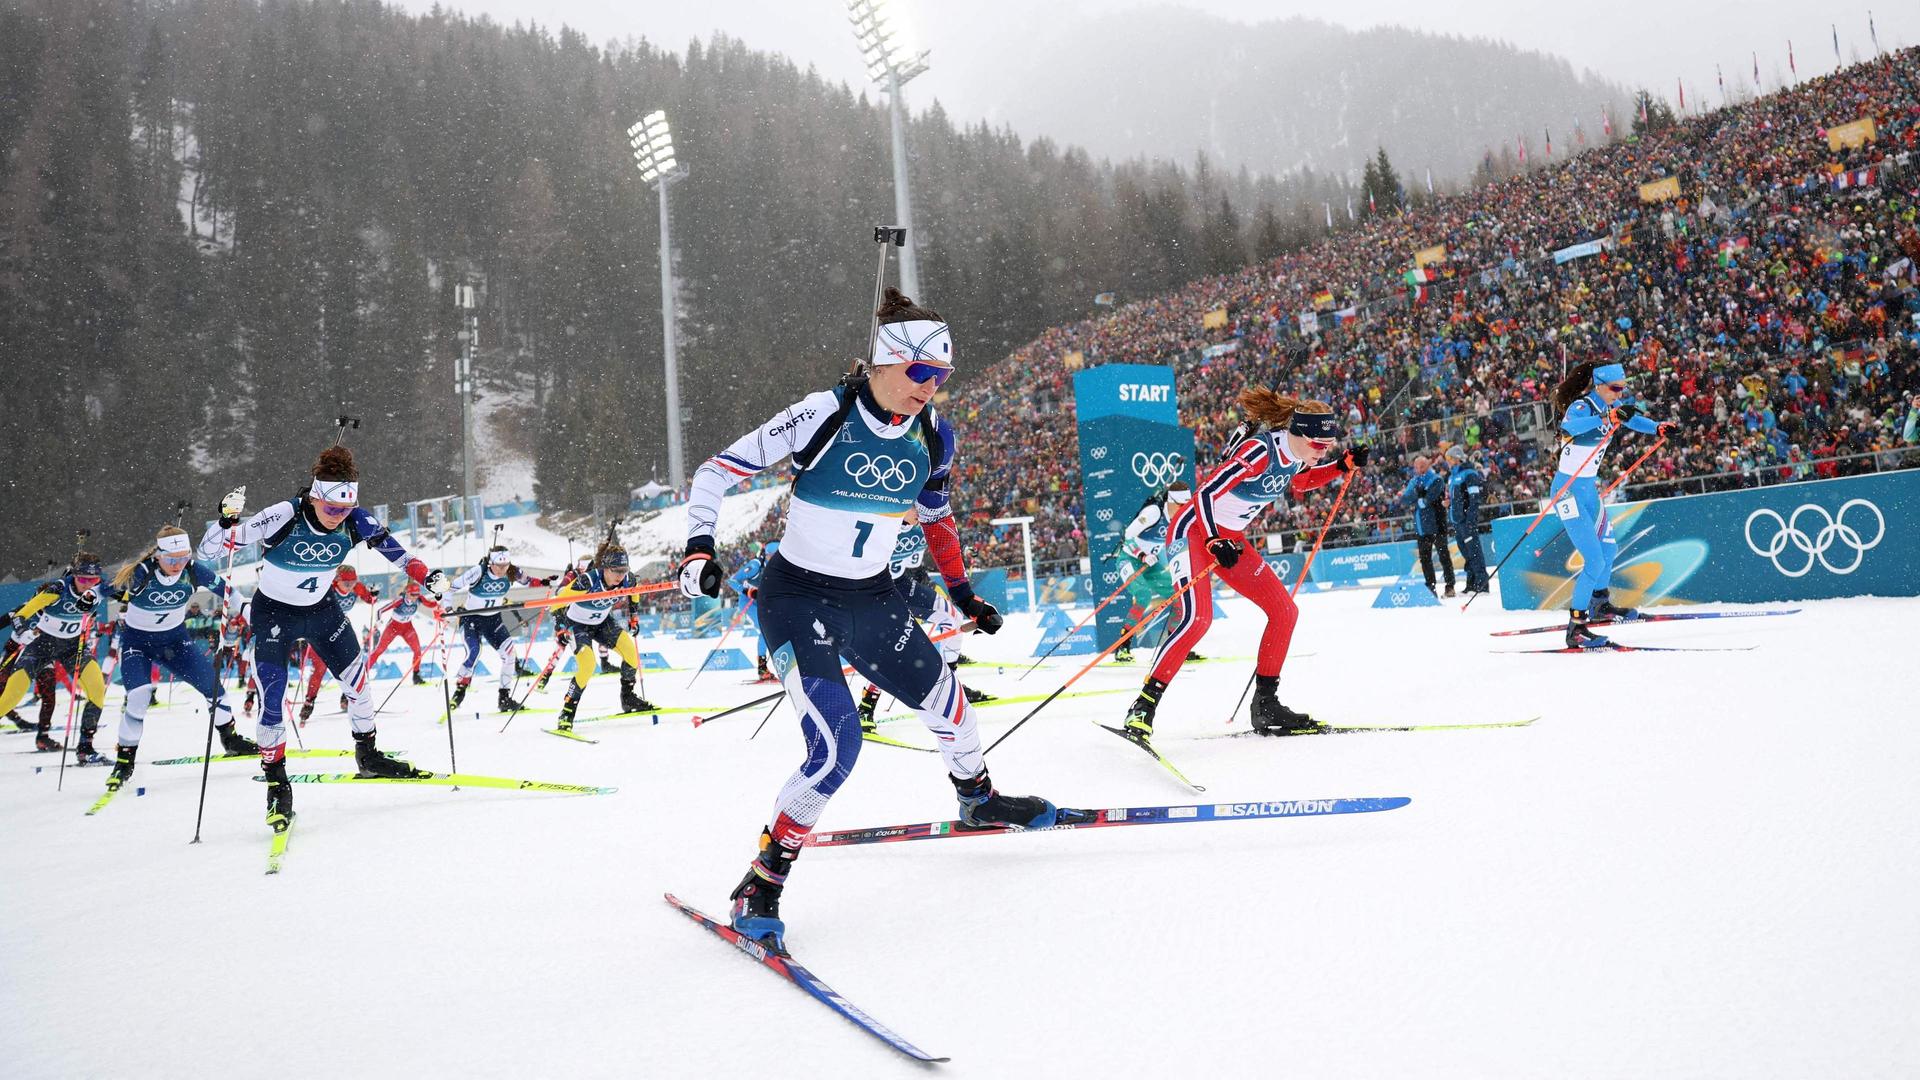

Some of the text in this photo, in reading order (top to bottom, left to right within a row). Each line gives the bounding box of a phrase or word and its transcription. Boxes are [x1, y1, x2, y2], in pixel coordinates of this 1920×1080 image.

[1118, 383, 1170, 402] START
[769, 412, 806, 437] CRAFT
[1564, 446, 1571, 456] 3
[831, 489, 868, 499] MILANO
[868, 494, 901, 504] CORTINA
[1238, 504, 1261, 519] 2
[1562, 503, 1570, 514] 3
[250, 515, 275, 529] CRAFT
[851, 520, 875, 559] 1
[911, 553, 920, 564] 9
[1330, 552, 1391, 566] MILANO CORTINA
[890, 560, 902, 574] 5
[1173, 560, 1181, 574] 2
[296, 576, 319, 593] 4
[154, 612, 170, 625] 7
[58, 620, 81, 634] 10
[329, 618, 349, 642] CRAFT
[894, 614, 915, 652] CRAFT
[538, 783, 599, 793] FISCHER
[1232, 799, 1334, 817] SALOMON
[735, 935, 767, 961] SALOMON
